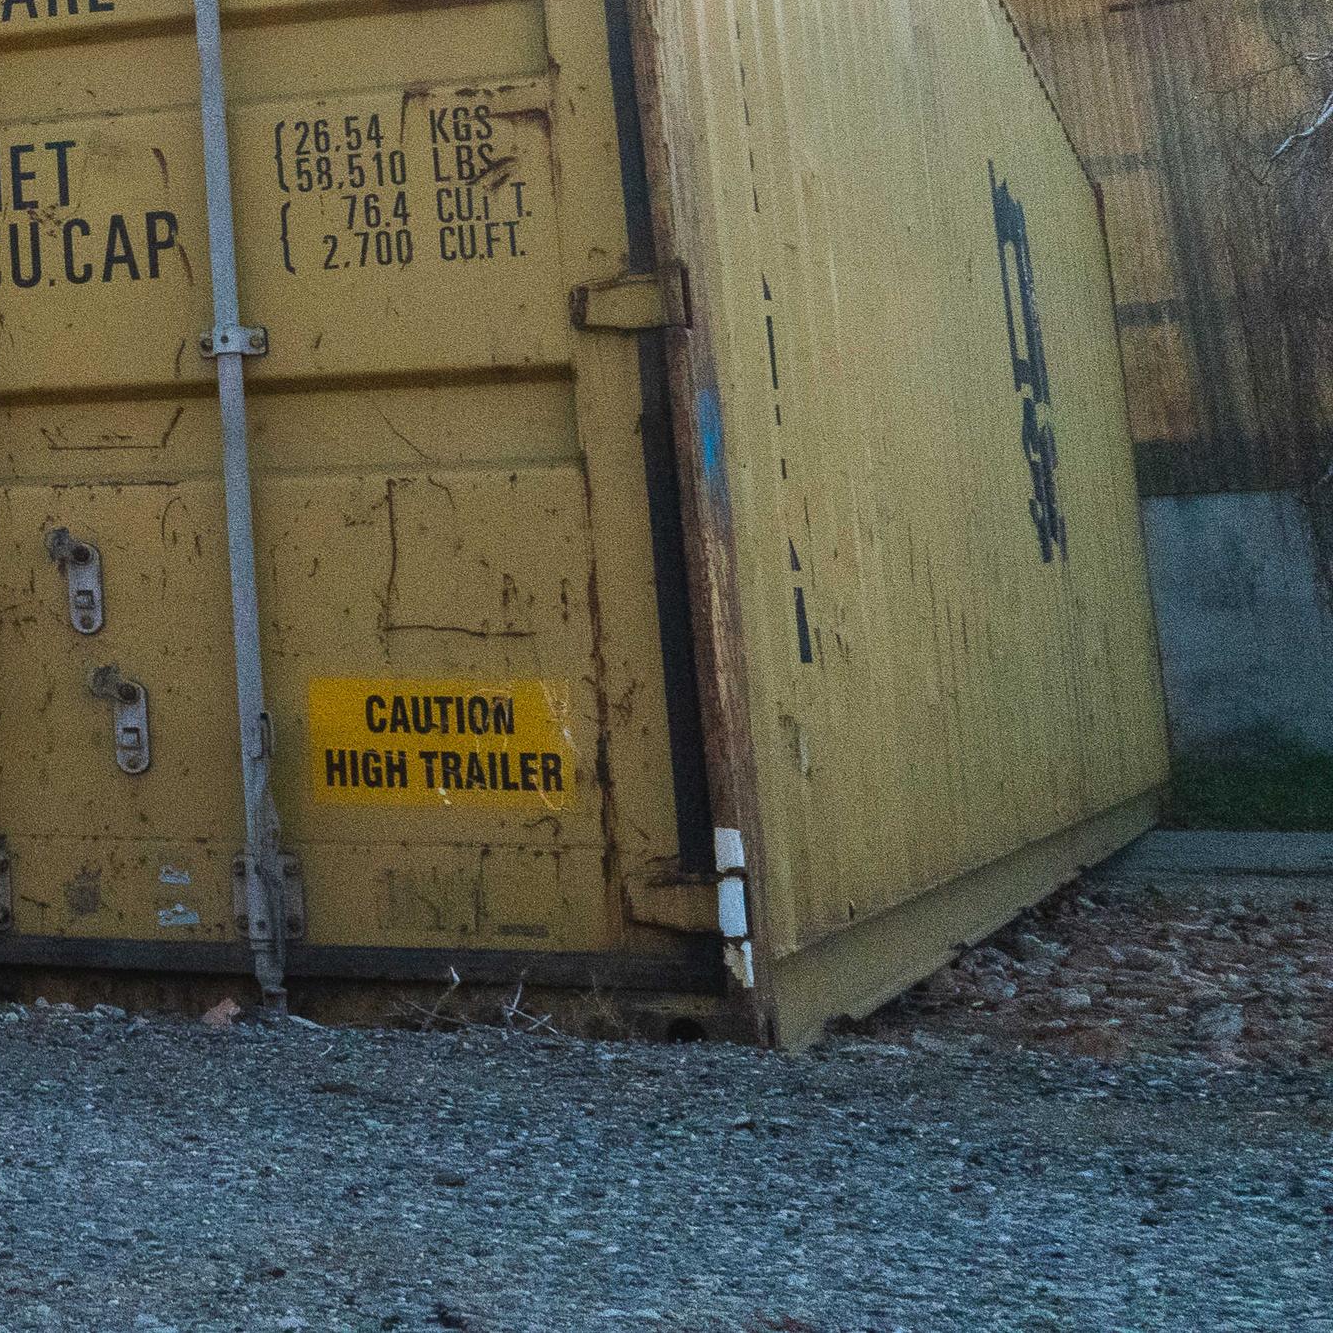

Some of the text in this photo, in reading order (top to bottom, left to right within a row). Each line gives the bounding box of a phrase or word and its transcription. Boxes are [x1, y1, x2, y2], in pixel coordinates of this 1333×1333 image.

[429, 105, 493, 145] KGS
[433, 143, 495, 183] LBS
[341, 191, 410, 229] 76.4
[440, 221, 526, 262] CU.FT.
[365, 694, 515, 736] CAUTION
[325, 749, 564, 793] HIGH TRAILER
